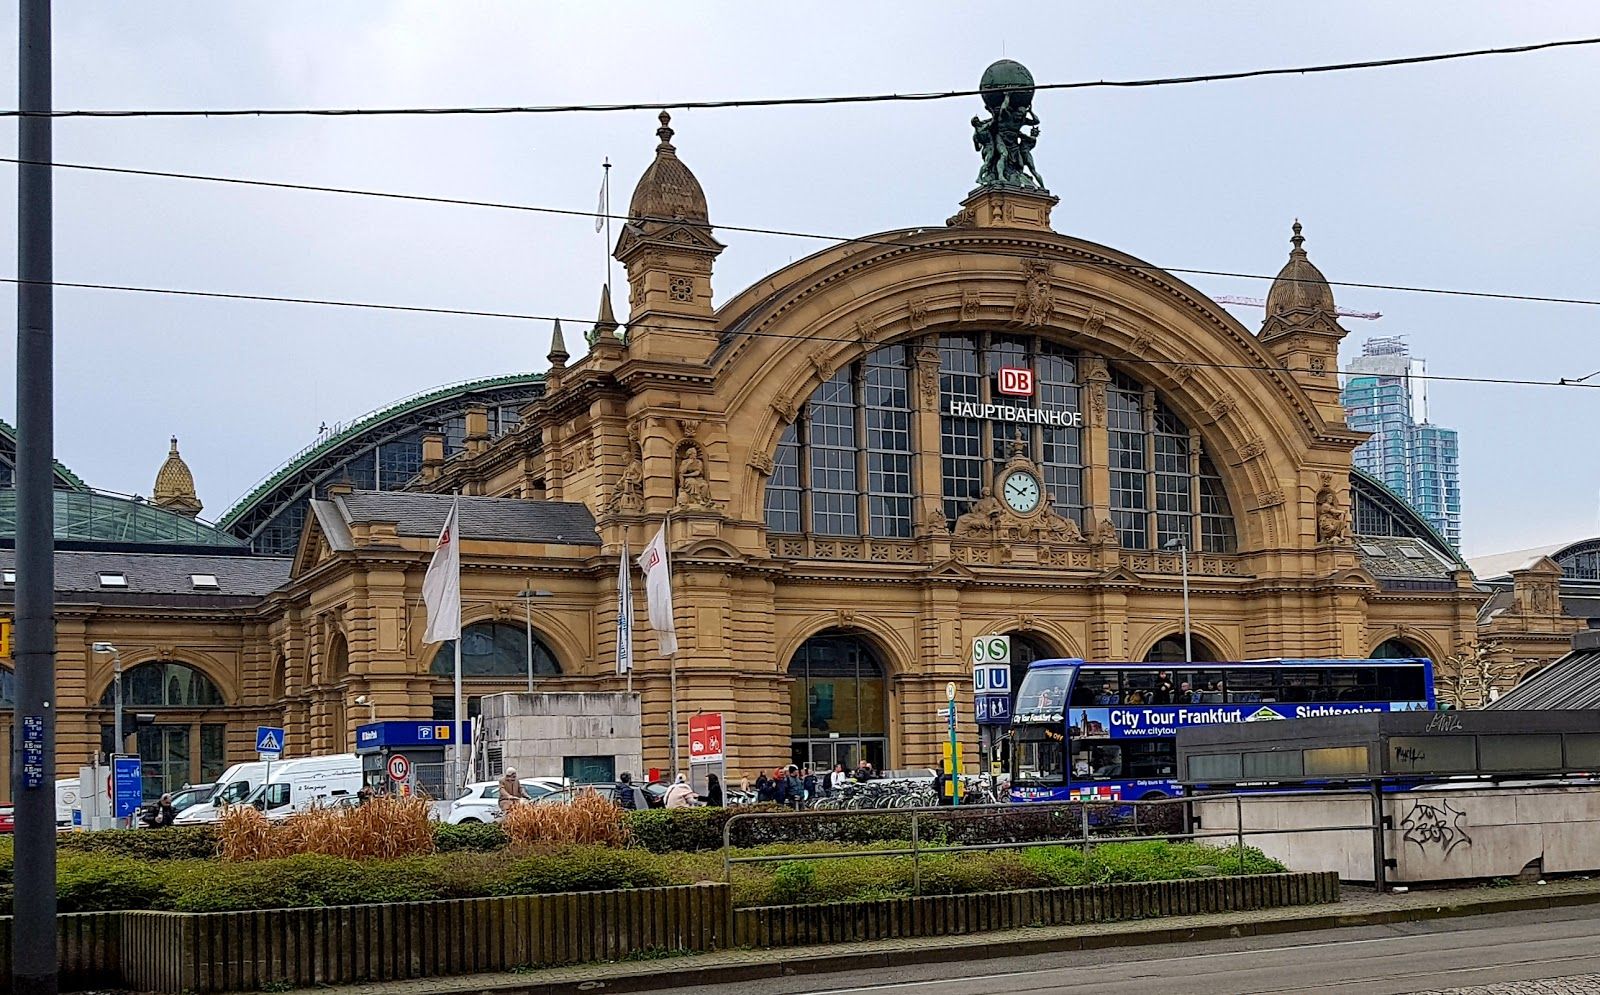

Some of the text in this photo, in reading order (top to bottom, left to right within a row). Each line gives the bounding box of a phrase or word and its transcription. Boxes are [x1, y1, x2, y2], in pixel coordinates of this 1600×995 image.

[1004, 371, 1029, 391] DB
[950, 400, 1082, 426] HAUPTBAHNHOF
[975, 640, 983, 660] S
[990, 639, 1005, 659] S
[977, 669, 984, 688] U
[992, 669, 1004, 688] U
[1111, 708, 1242, 728] City Tour Frankfurt
[1123, 727, 1177, 736] www.citytou
[393, 761, 404, 774] 10
